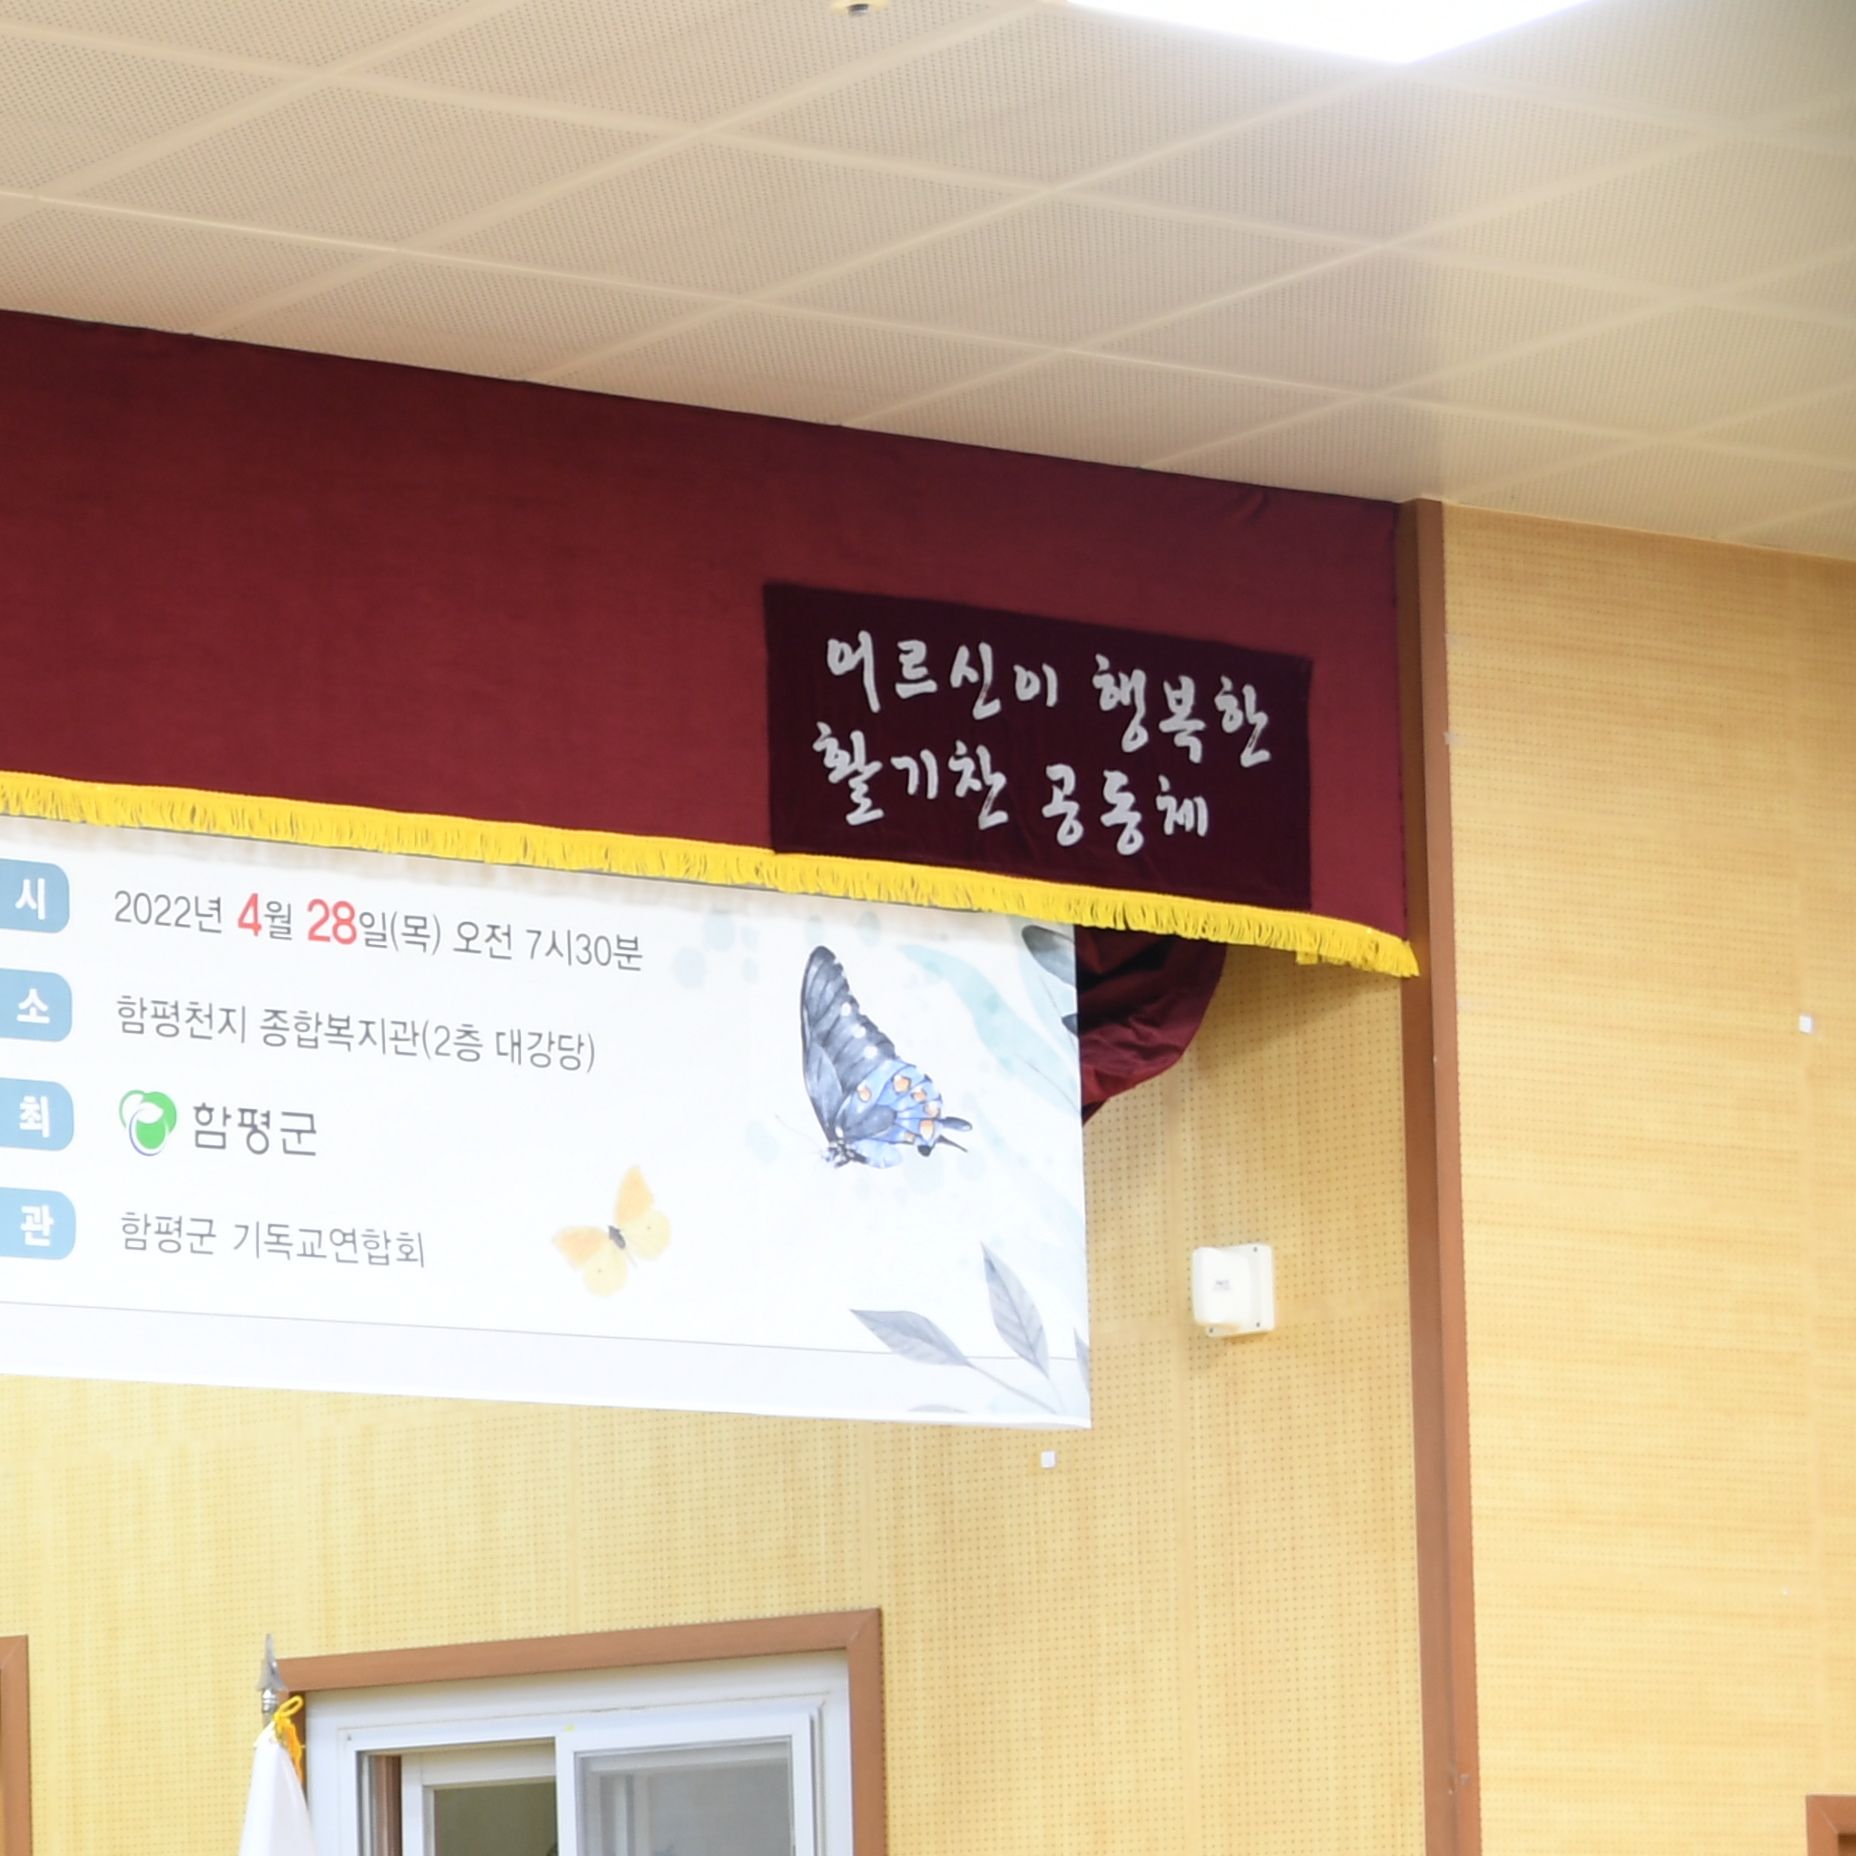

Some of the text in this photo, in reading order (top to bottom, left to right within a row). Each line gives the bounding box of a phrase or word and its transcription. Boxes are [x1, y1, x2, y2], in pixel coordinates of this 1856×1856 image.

[826, 631, 1270, 767] 어르신이 행복한
[813, 721, 1208, 855] 활기찬 공동체
[114, 890, 644, 972] 2022년 4월 28일(목) 오전 7시30분
[116, 994, 596, 1074] 함평천지 종합복지관(2층 대강당)
[192, 1101, 318, 1157] 함평군
[121, 1211, 425, 1268] 함평군 기독교연합회
